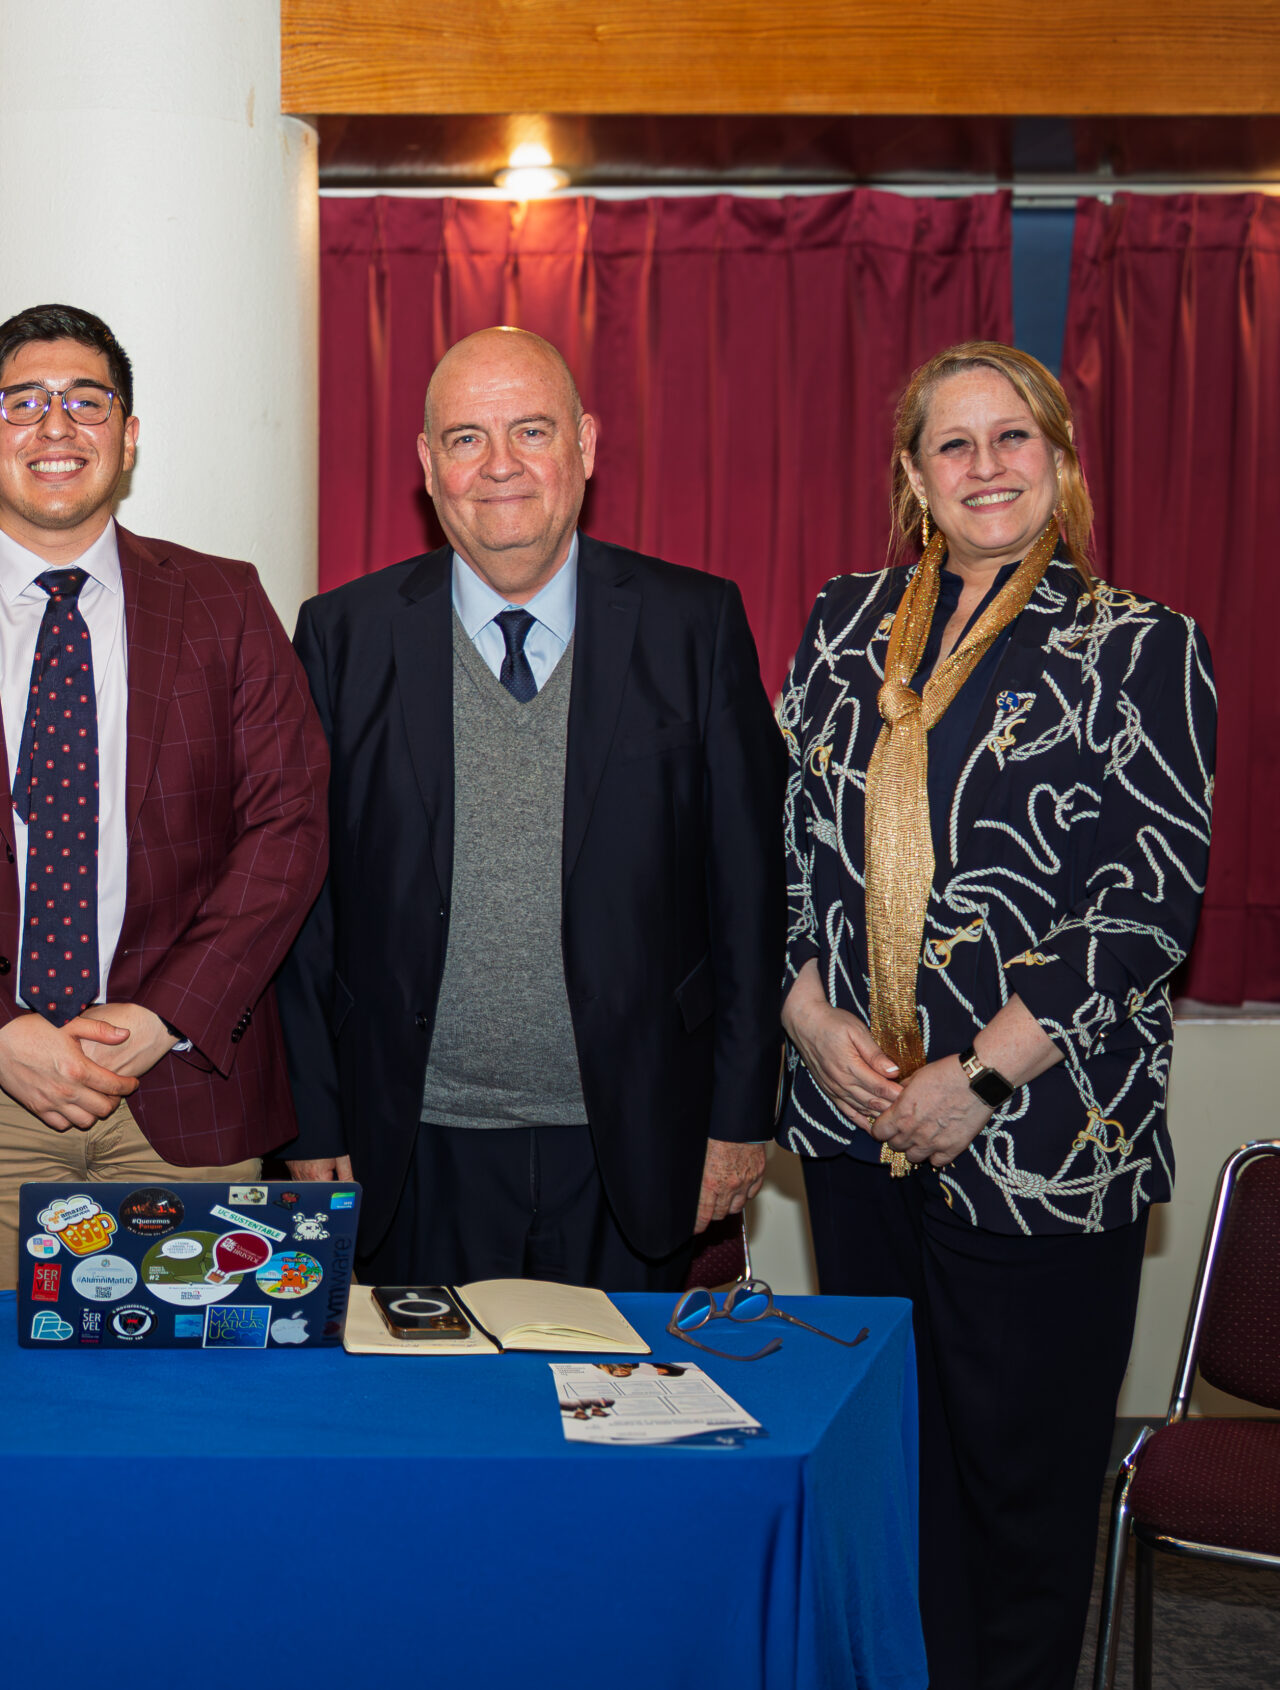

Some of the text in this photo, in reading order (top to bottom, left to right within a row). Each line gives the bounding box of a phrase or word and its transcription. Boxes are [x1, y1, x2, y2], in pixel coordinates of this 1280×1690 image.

[60, 1204, 89, 1218] amazon
[131, 1217, 171, 1225] #Queremos
[217, 1208, 282, 1239] UC SUSTENTABLE
[36, 1268, 59, 1281] SER
[36, 1280, 57, 1292] VEL
[82, 1312, 102, 1322] SER
[210, 1307, 261, 1321] MATE
[82, 1321, 101, 1332] VEL
[209, 1318, 265, 1329] MATICAS
[208, 1327, 236, 1340] UC
